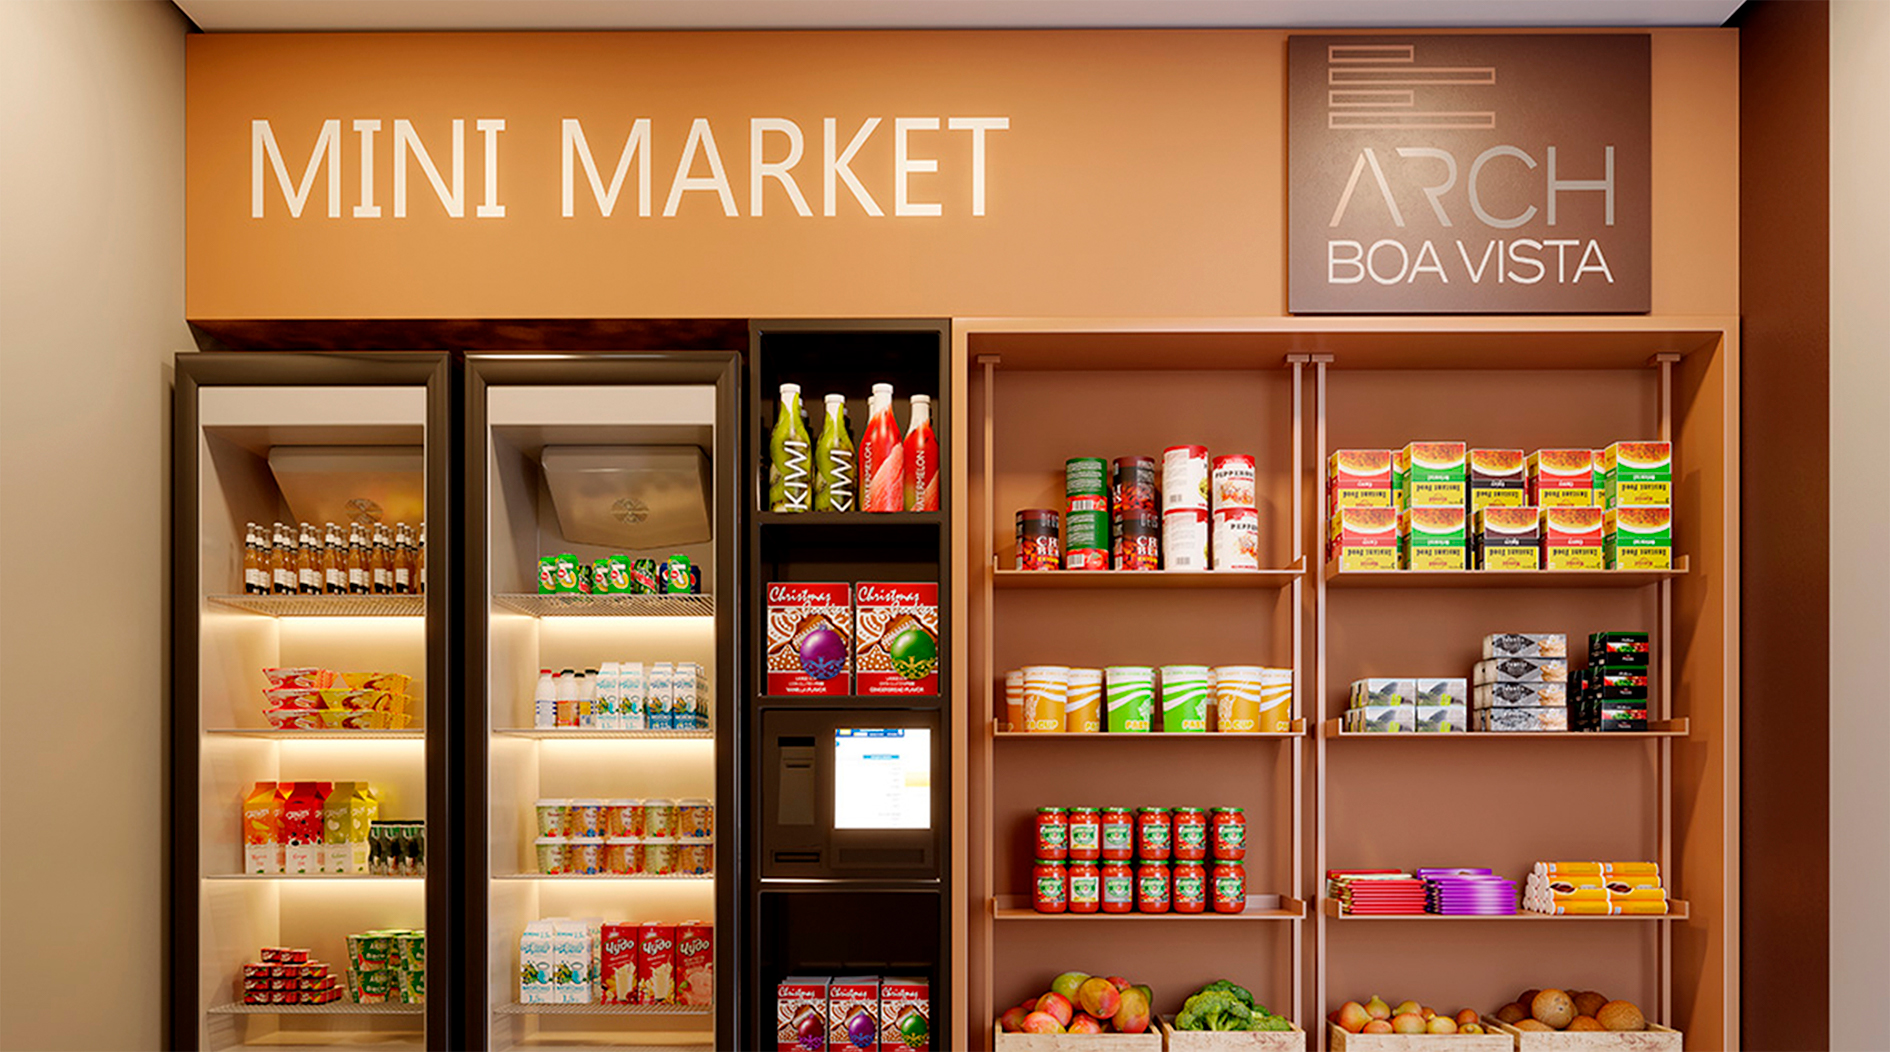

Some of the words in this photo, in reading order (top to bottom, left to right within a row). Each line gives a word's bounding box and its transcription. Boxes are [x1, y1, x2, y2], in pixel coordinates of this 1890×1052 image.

[250, 118, 506, 218] MINI
[560, 117, 1010, 217] MARKET
[1328, 145, 1615, 229] ARCH
[1328, 239, 1449, 285] BOA
[1456, 239, 1615, 285] VISTA
[783, 441, 808, 510] KIWI
[863, 442, 872, 510] WATERMELON
[769, 586, 831, 602] Christmas
[858, 586, 920, 602] Christmas
